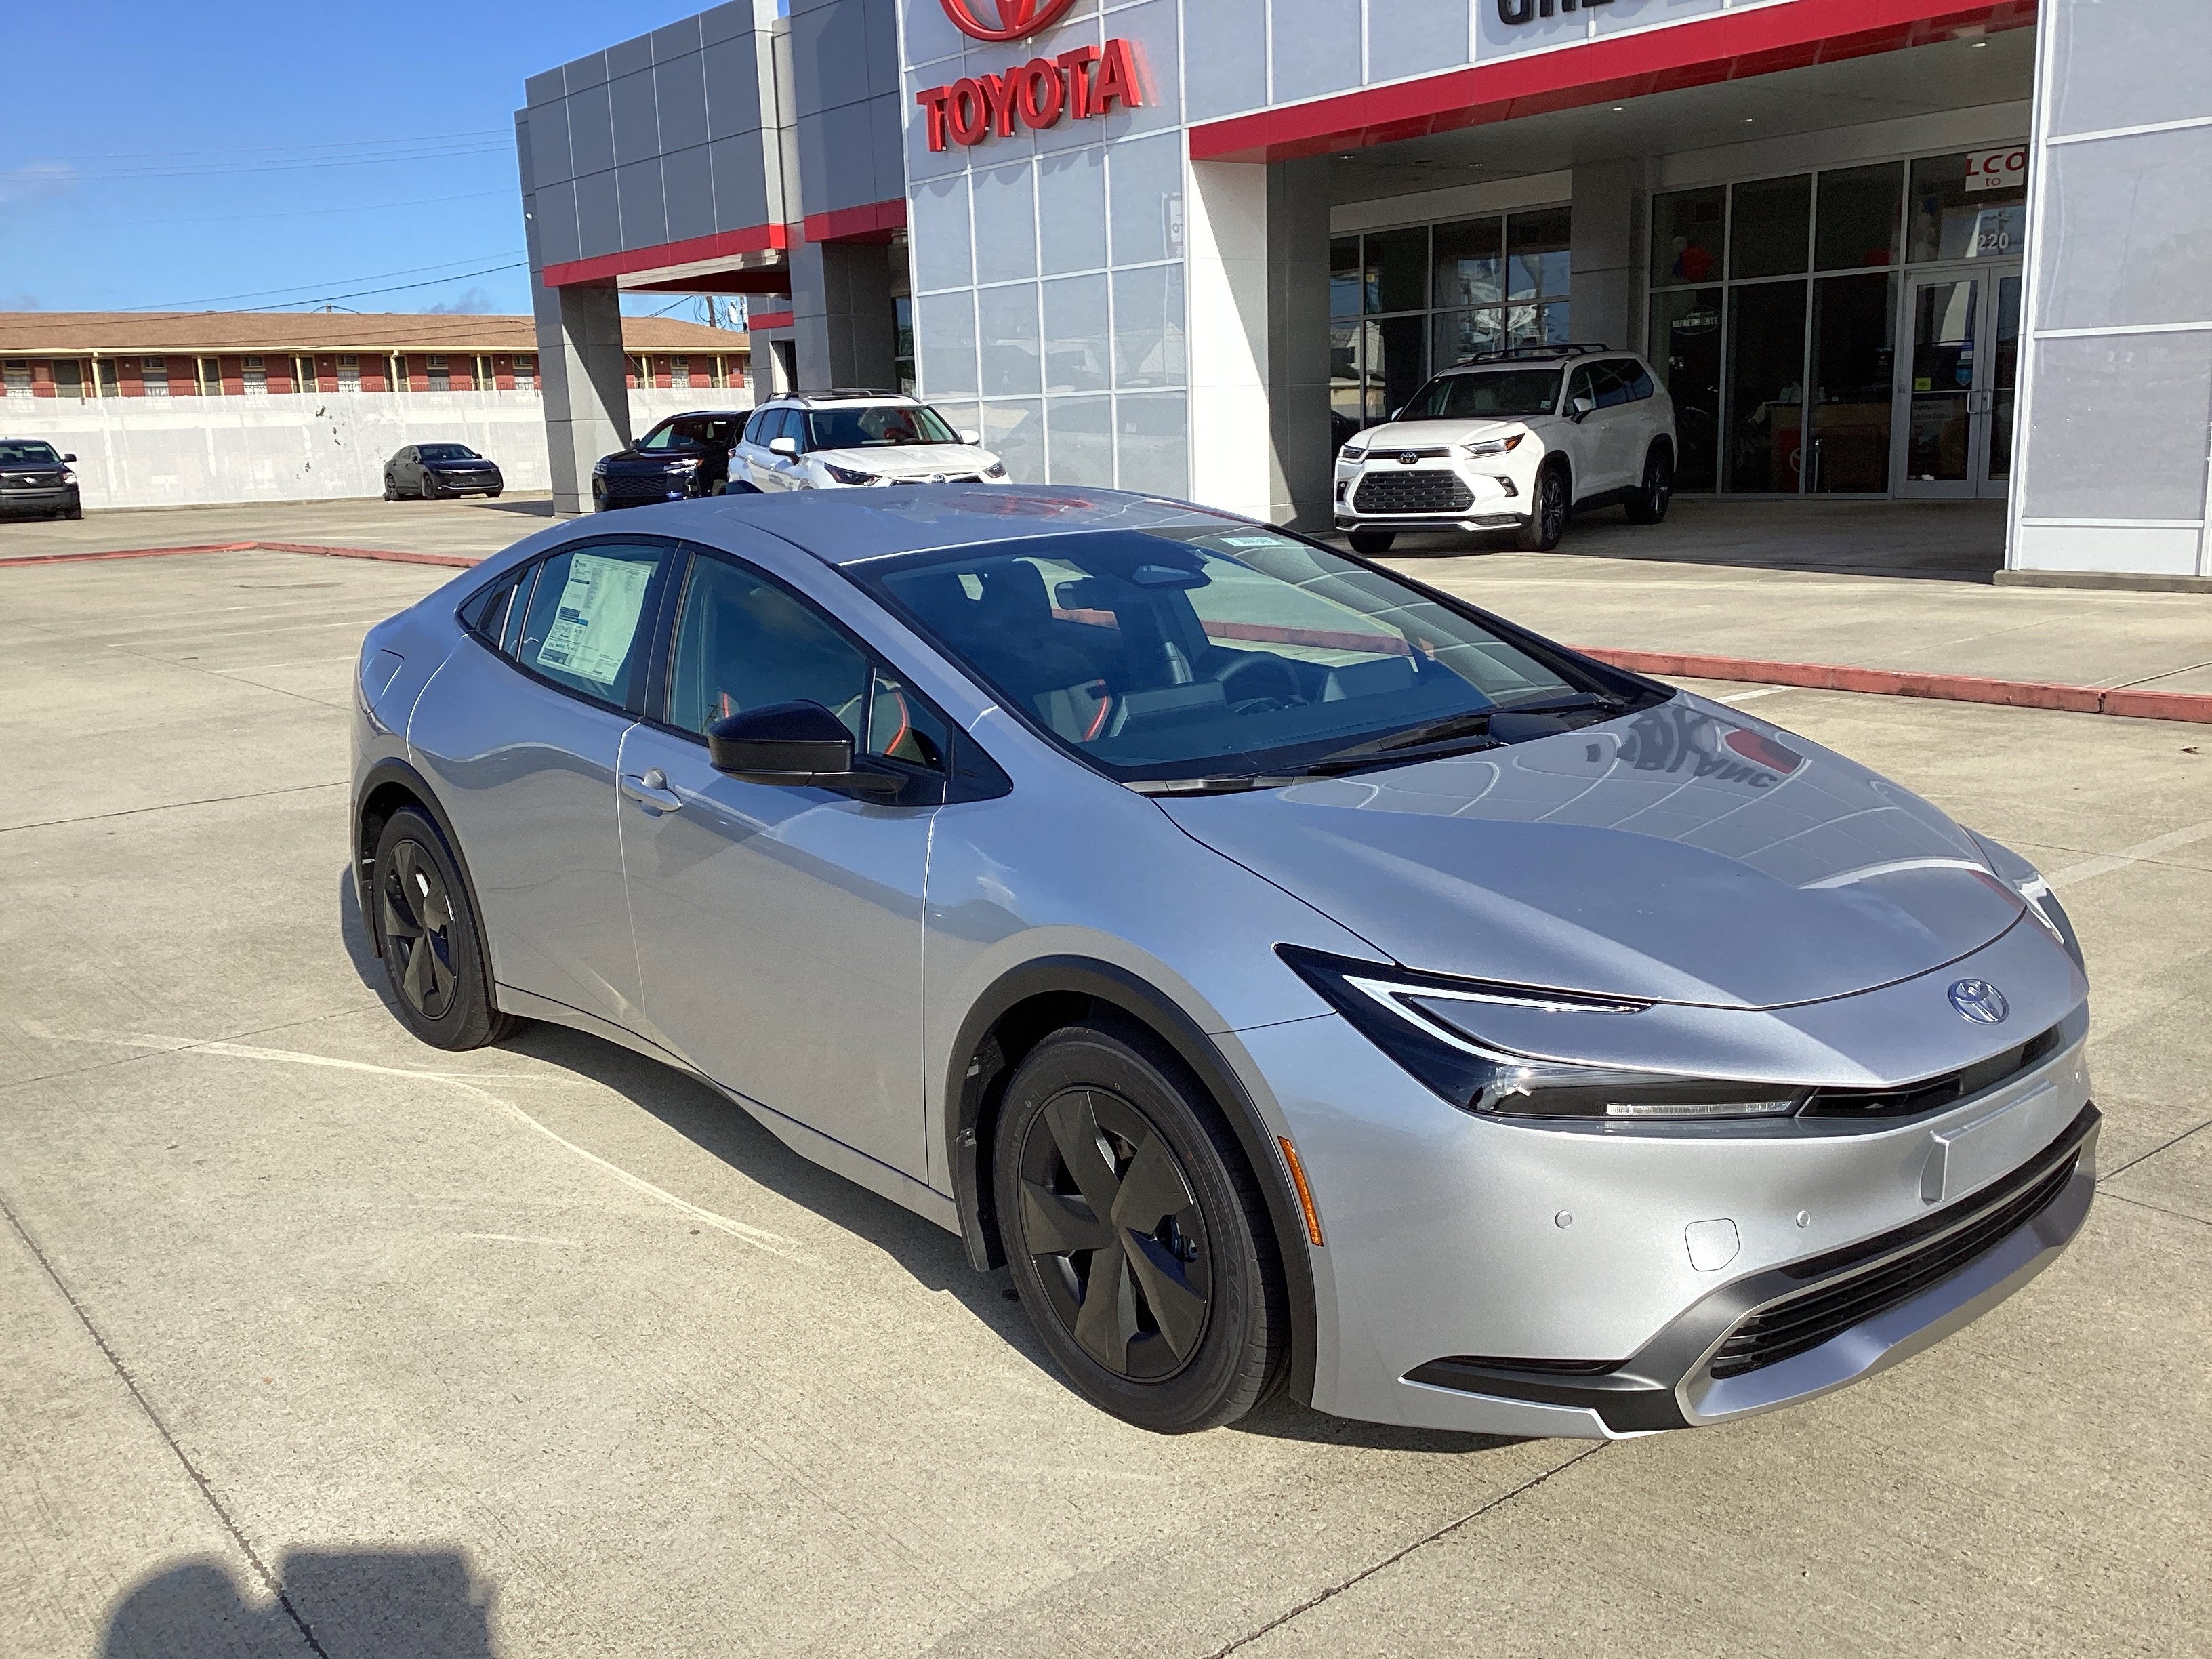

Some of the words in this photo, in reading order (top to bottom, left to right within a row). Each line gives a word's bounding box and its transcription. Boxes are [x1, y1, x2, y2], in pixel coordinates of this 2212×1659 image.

[916, 39, 1143, 152] TOYOTA
[1985, 177, 2001, 187] to
[1978, 232, 2009, 251] 220
